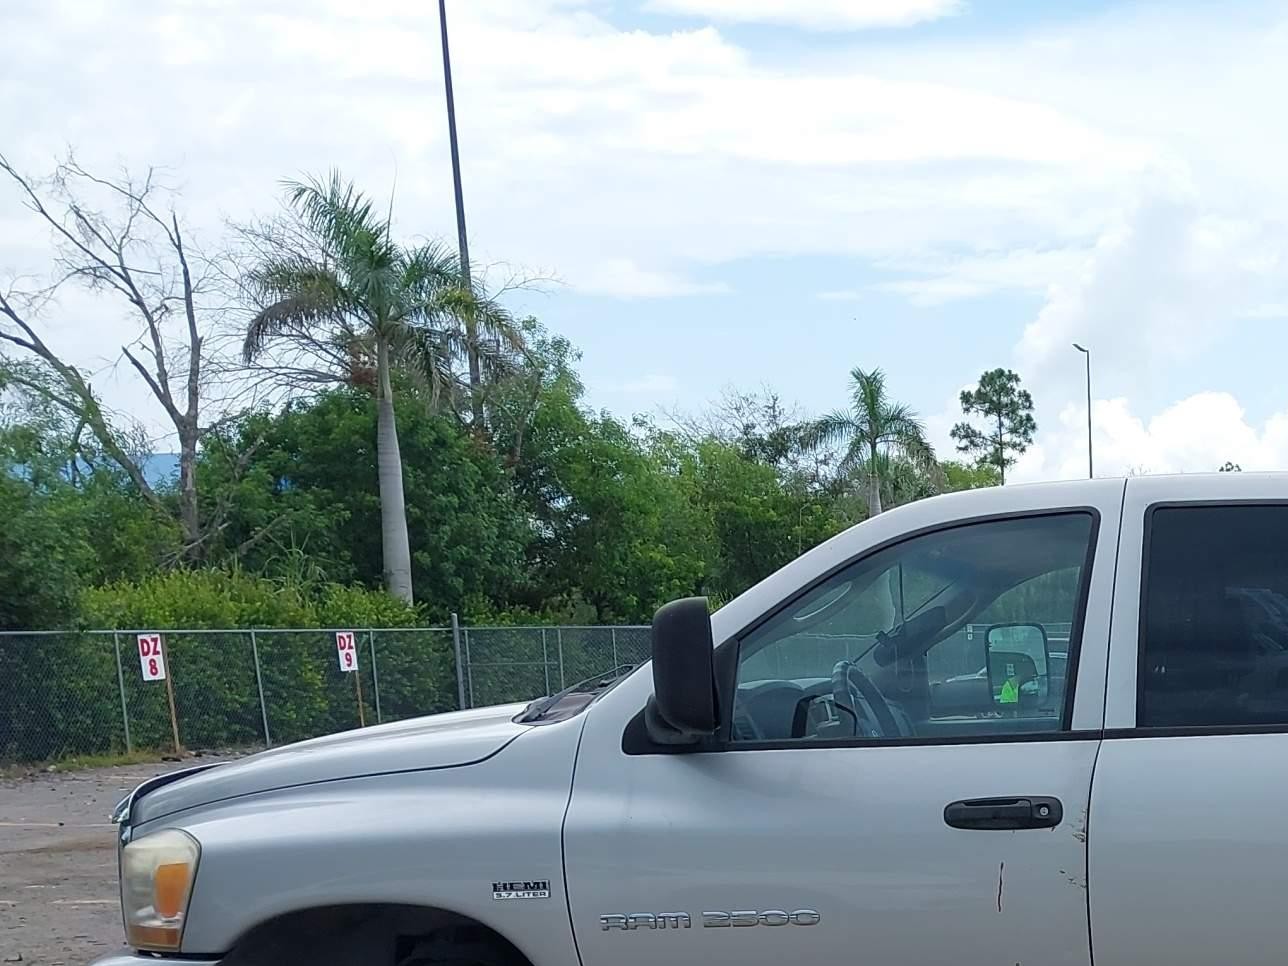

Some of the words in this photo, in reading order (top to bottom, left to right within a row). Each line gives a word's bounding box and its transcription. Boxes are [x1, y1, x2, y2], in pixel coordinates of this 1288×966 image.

[140, 637, 160, 657] DZ
[338, 634, 354, 650] DZ
[149, 658, 158, 676] 8
[345, 652, 352, 668] 9
[492, 881, 548, 891] HEMI
[600, 912, 691, 931] RAM
[702, 910, 820, 928] 2500
